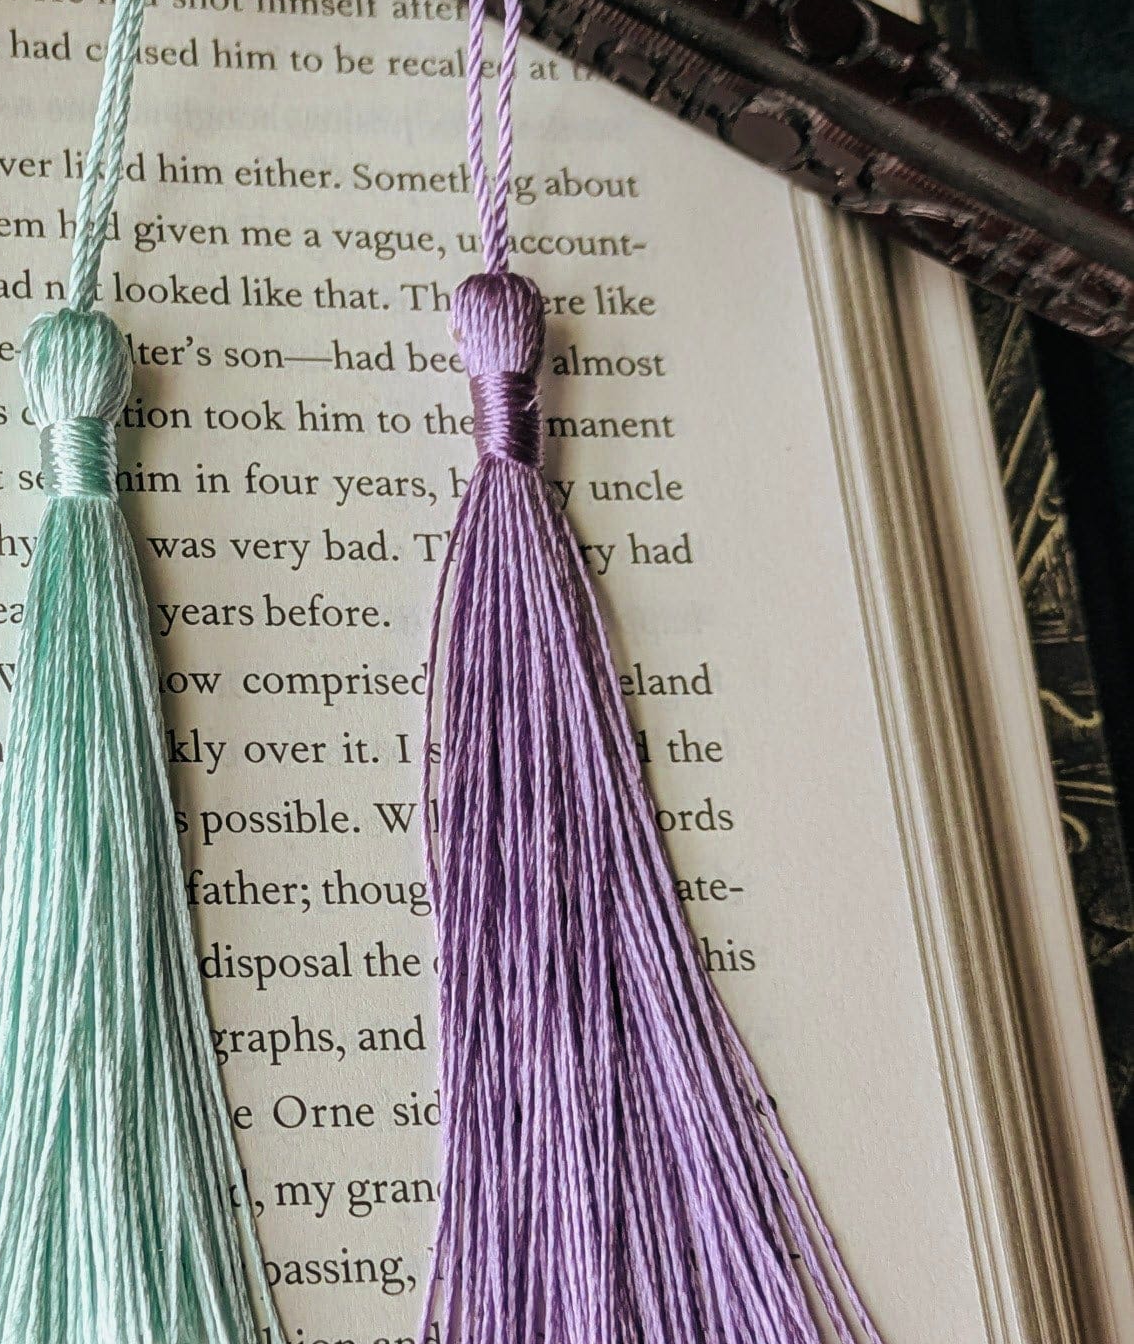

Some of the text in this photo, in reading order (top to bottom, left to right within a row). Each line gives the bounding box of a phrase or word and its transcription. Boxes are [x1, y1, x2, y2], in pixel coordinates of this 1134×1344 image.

[9, 27, 71, 61] had
[211, 37, 277, 70] him
[333, 42, 374, 75] be
[157, 152, 224, 185] him
[235, 157, 340, 189] either.
[544, 167, 639, 198] about
[134, 214, 229, 253] given
[240, 226, 291, 247] me
[332, 228, 446, 260] vague,
[113, 271, 231, 305] looked
[240, 275, 302, 308] like
[313, 277, 390, 310] that.
[593, 285, 656, 316] like
[550, 344, 665, 377] almost
[204, 399, 286, 431] took
[295, 399, 365, 433] him
[377, 410, 411, 434] to
[195, 463, 231, 494] in
[244, 461, 319, 496] four
[332, 476, 437, 507] years,
[589, 469, 684, 501] uncle
[148, 533, 216, 561] was
[229, 541, 311, 571] very
[322, 528, 399, 562] bad.
[627, 532, 694, 564] had
[158, 598, 254, 637] years
[262, 593, 390, 627] before.
[244, 741, 327, 764] over
[342, 732, 384, 764] it.
[666, 729, 724, 763] the
[200, 798, 360, 846] possible.
[200, 941, 357, 991] disposal
[363, 939, 421, 977] the
[357, 1013, 427, 1055] and
[271, 1092, 375, 1130] Orne
[274, 1181, 336, 1218] my
